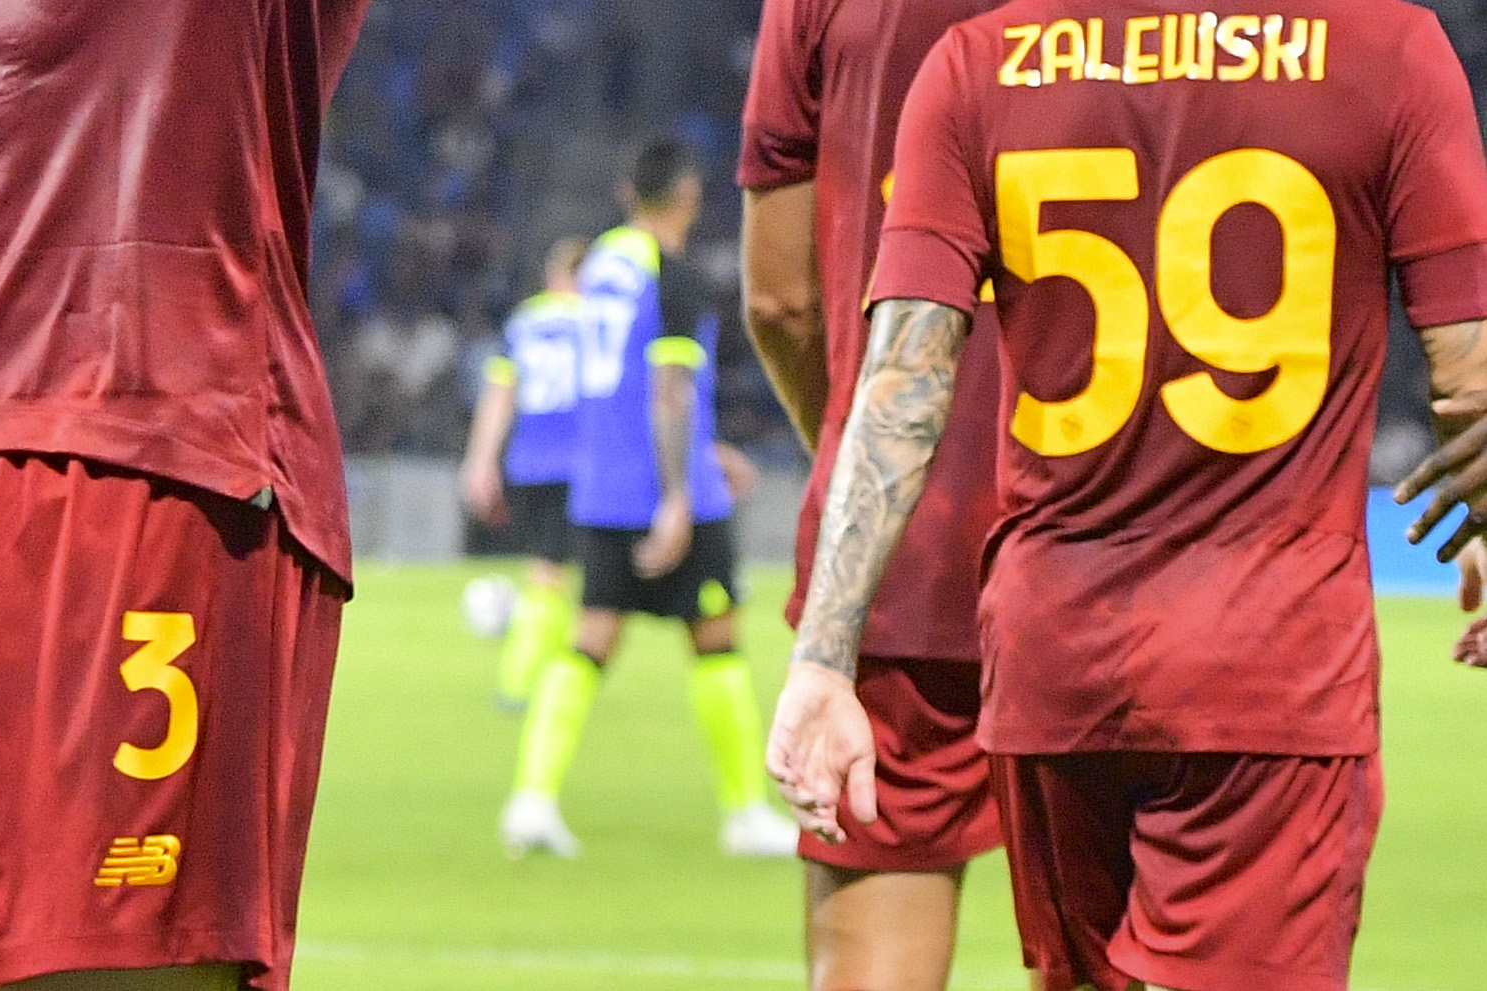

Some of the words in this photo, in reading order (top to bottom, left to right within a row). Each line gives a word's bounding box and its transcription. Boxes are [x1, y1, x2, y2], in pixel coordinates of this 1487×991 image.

[998, 11, 1328, 87] ZALEWSKI
[994, 147, 1337, 457] 59
[113, 610, 199, 780] 3
